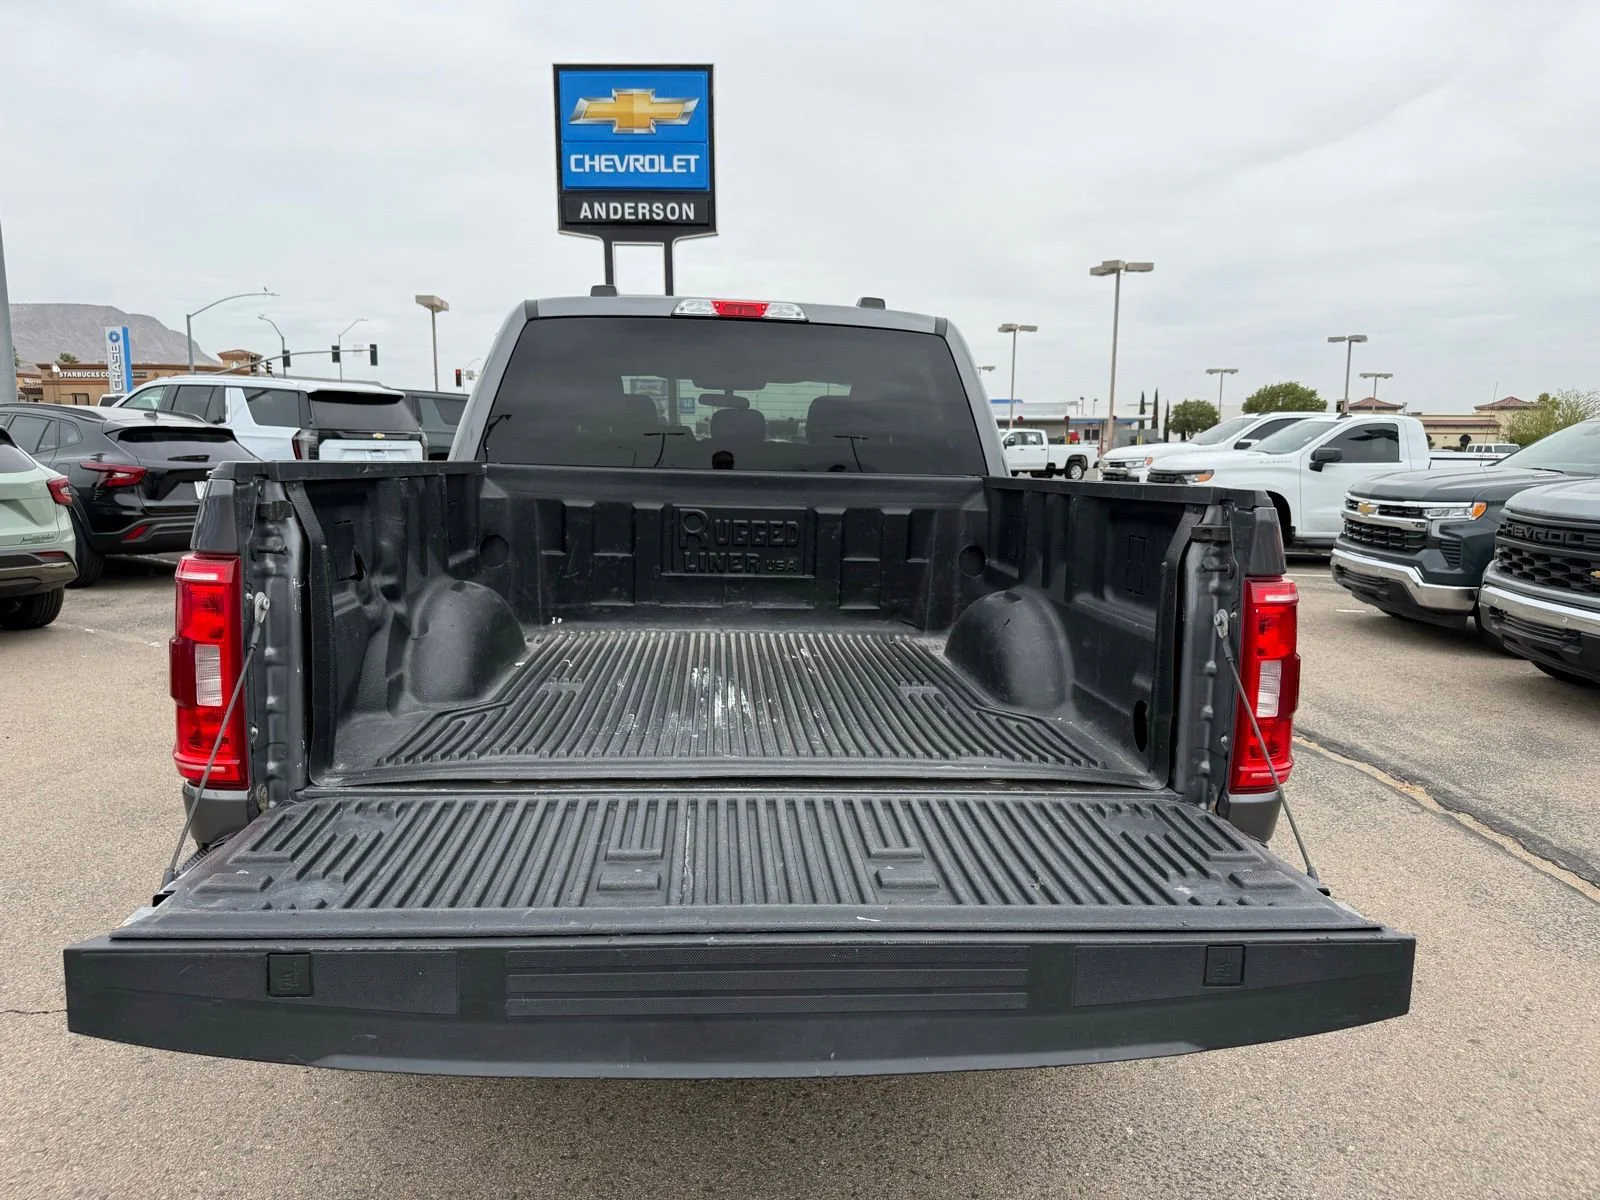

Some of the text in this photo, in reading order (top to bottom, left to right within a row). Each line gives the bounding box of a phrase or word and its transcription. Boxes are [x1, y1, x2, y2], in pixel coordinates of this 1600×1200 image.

[569, 154, 700, 173] CHEVROLET
[580, 202, 695, 220] ANDERSON
[111, 344, 123, 391] CHASE
[1500, 521, 1600, 546] HEVROLE
[684, 550, 797, 573] LINER USA
